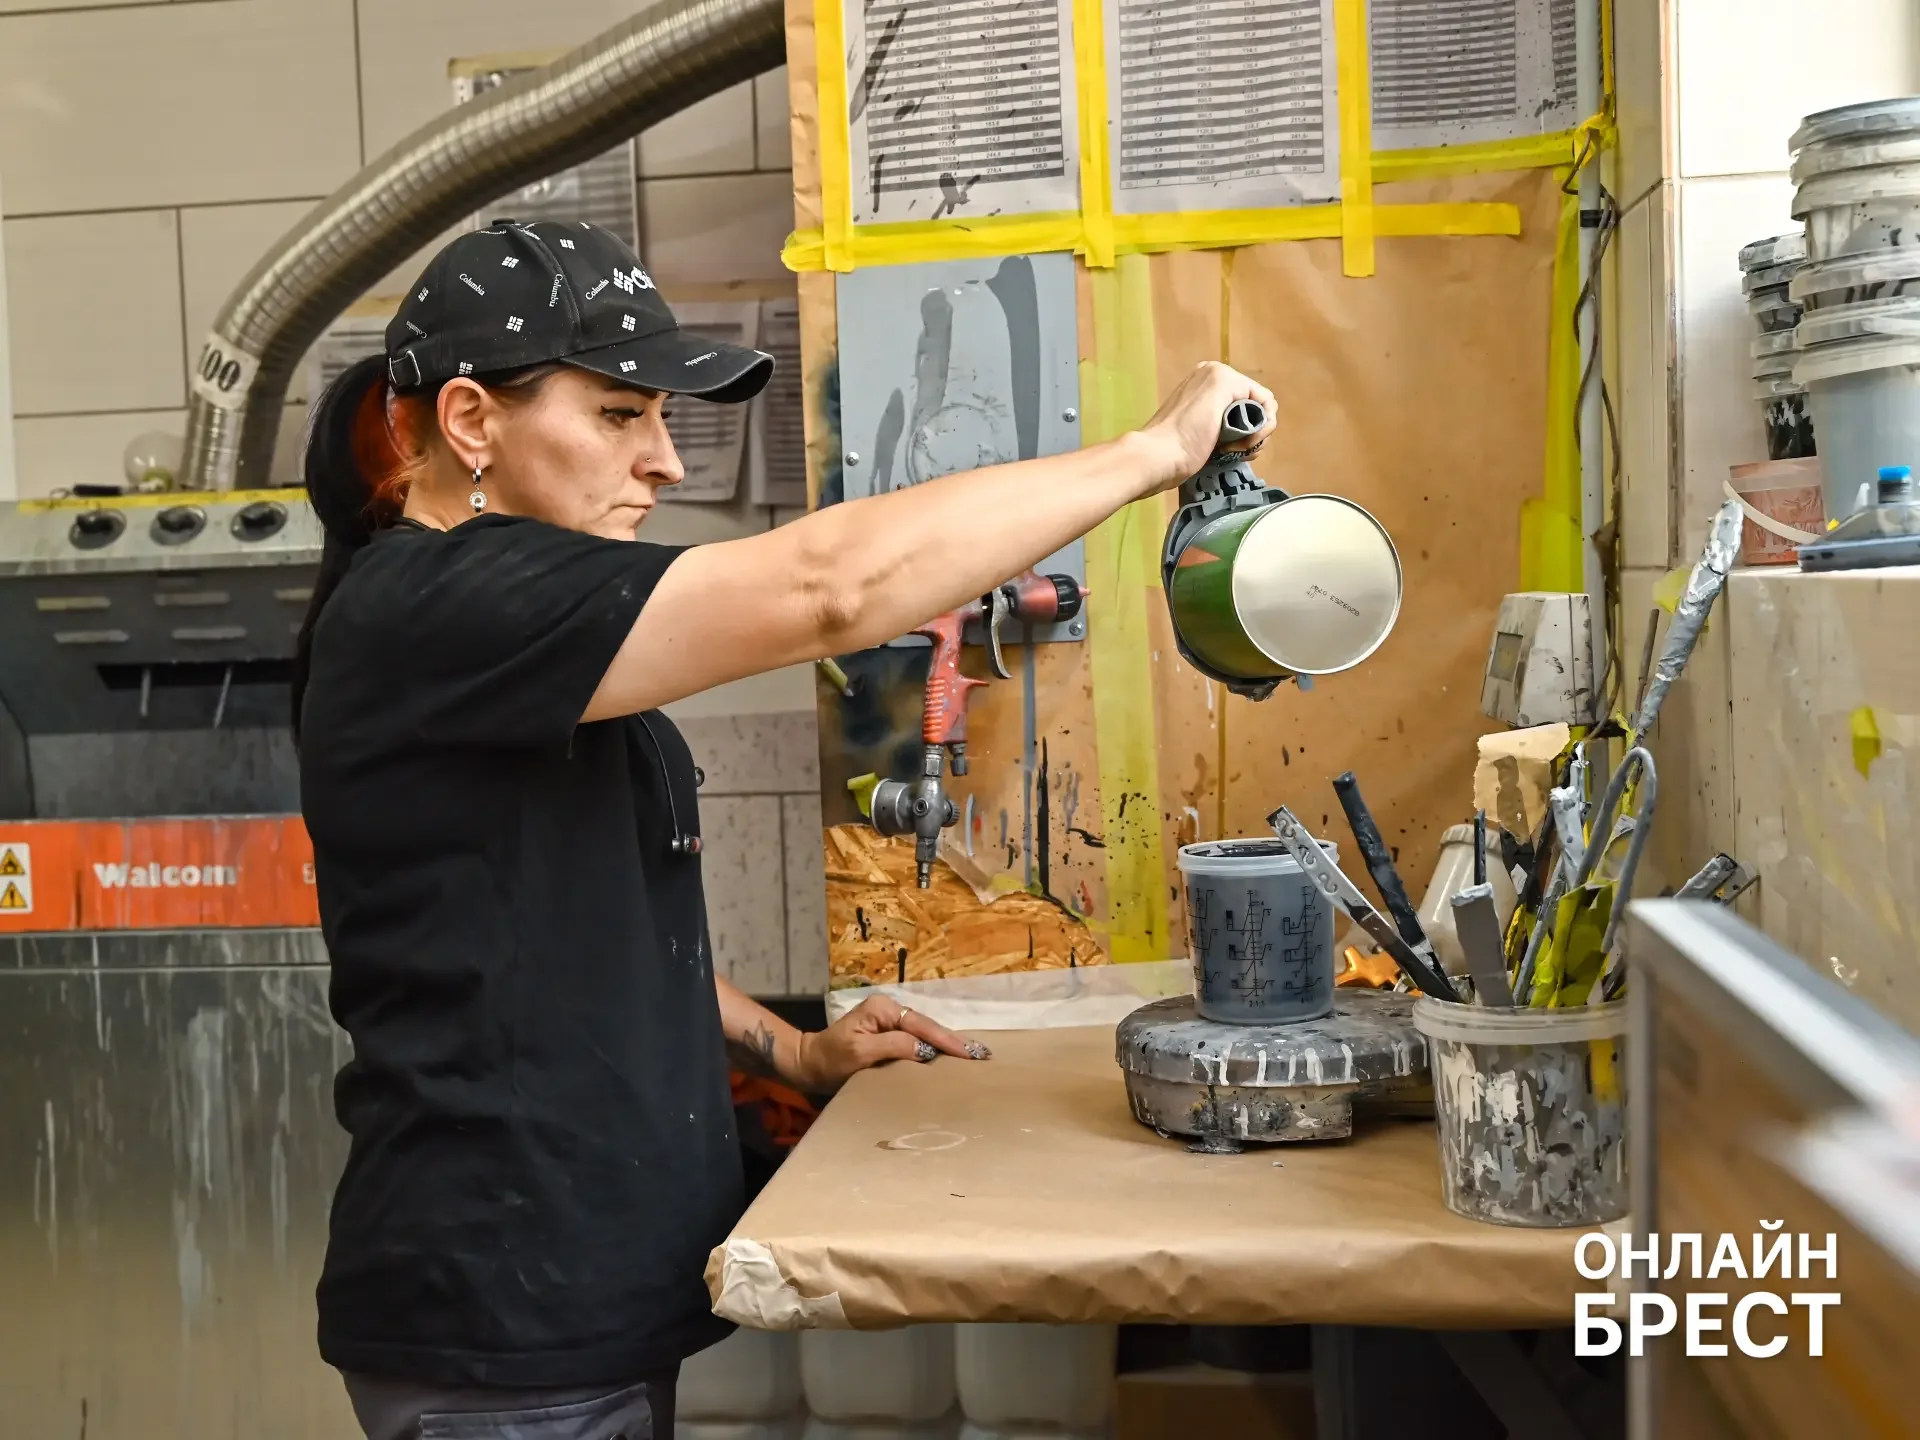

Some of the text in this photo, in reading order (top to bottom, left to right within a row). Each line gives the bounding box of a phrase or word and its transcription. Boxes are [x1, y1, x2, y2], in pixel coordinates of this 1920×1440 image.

[459, 273, 485, 296] Columbia
[549, 273, 564, 308] Columbia
[93, 862, 238, 888] Walcom
